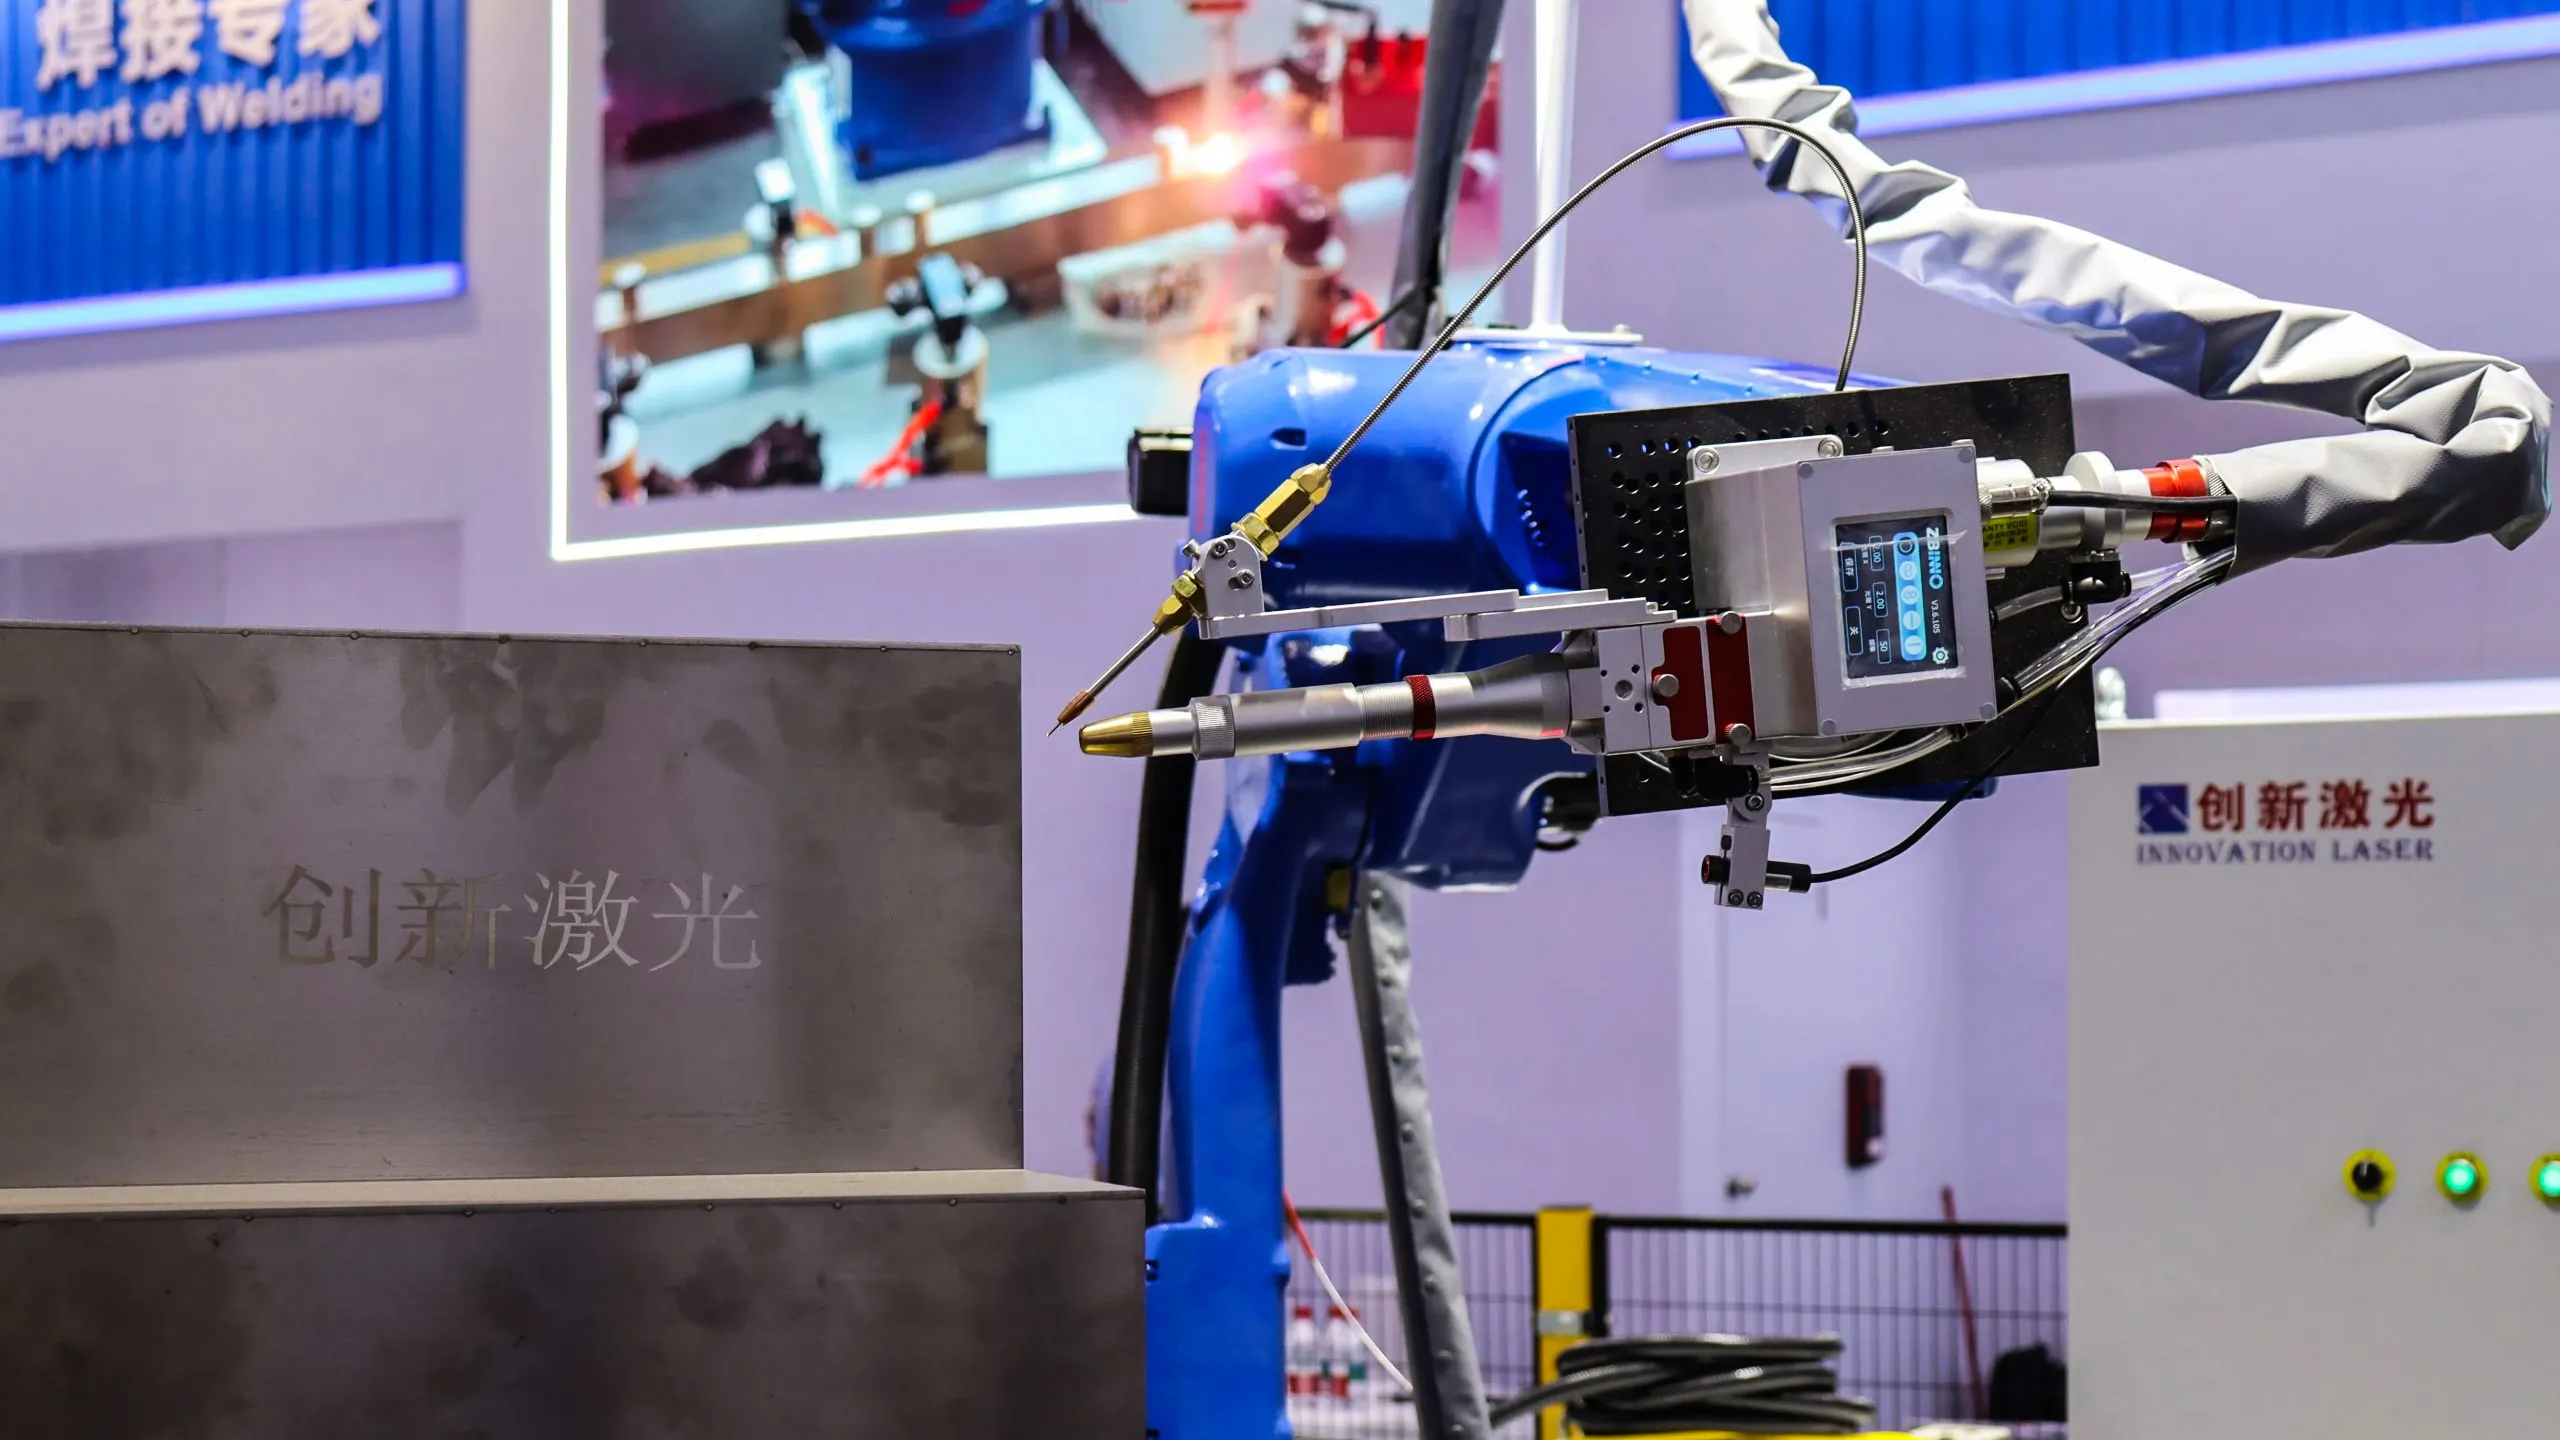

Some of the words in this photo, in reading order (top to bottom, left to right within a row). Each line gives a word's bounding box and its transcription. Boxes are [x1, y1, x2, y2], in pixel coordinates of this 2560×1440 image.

[0, 97, 134, 163] Expert
[141, 86, 191, 141] of
[199, 70, 383, 134] Welding
[2007, 519, 2028, 529] VOID
[1844, 557, 1855, 577] 保存
[1875, 590, 1885, 610] 2.00
[1930, 599, 1941, 634] V3.6.105
[1849, 626, 1860, 636] 关
[1879, 640, 1887, 653] 50
[2197, 777, 2436, 833] 创新激光
[2135, 838, 2318, 865] INNOVATION
[2330, 836, 2434, 863] LASER
[263, 863, 763, 973] 创新激光
